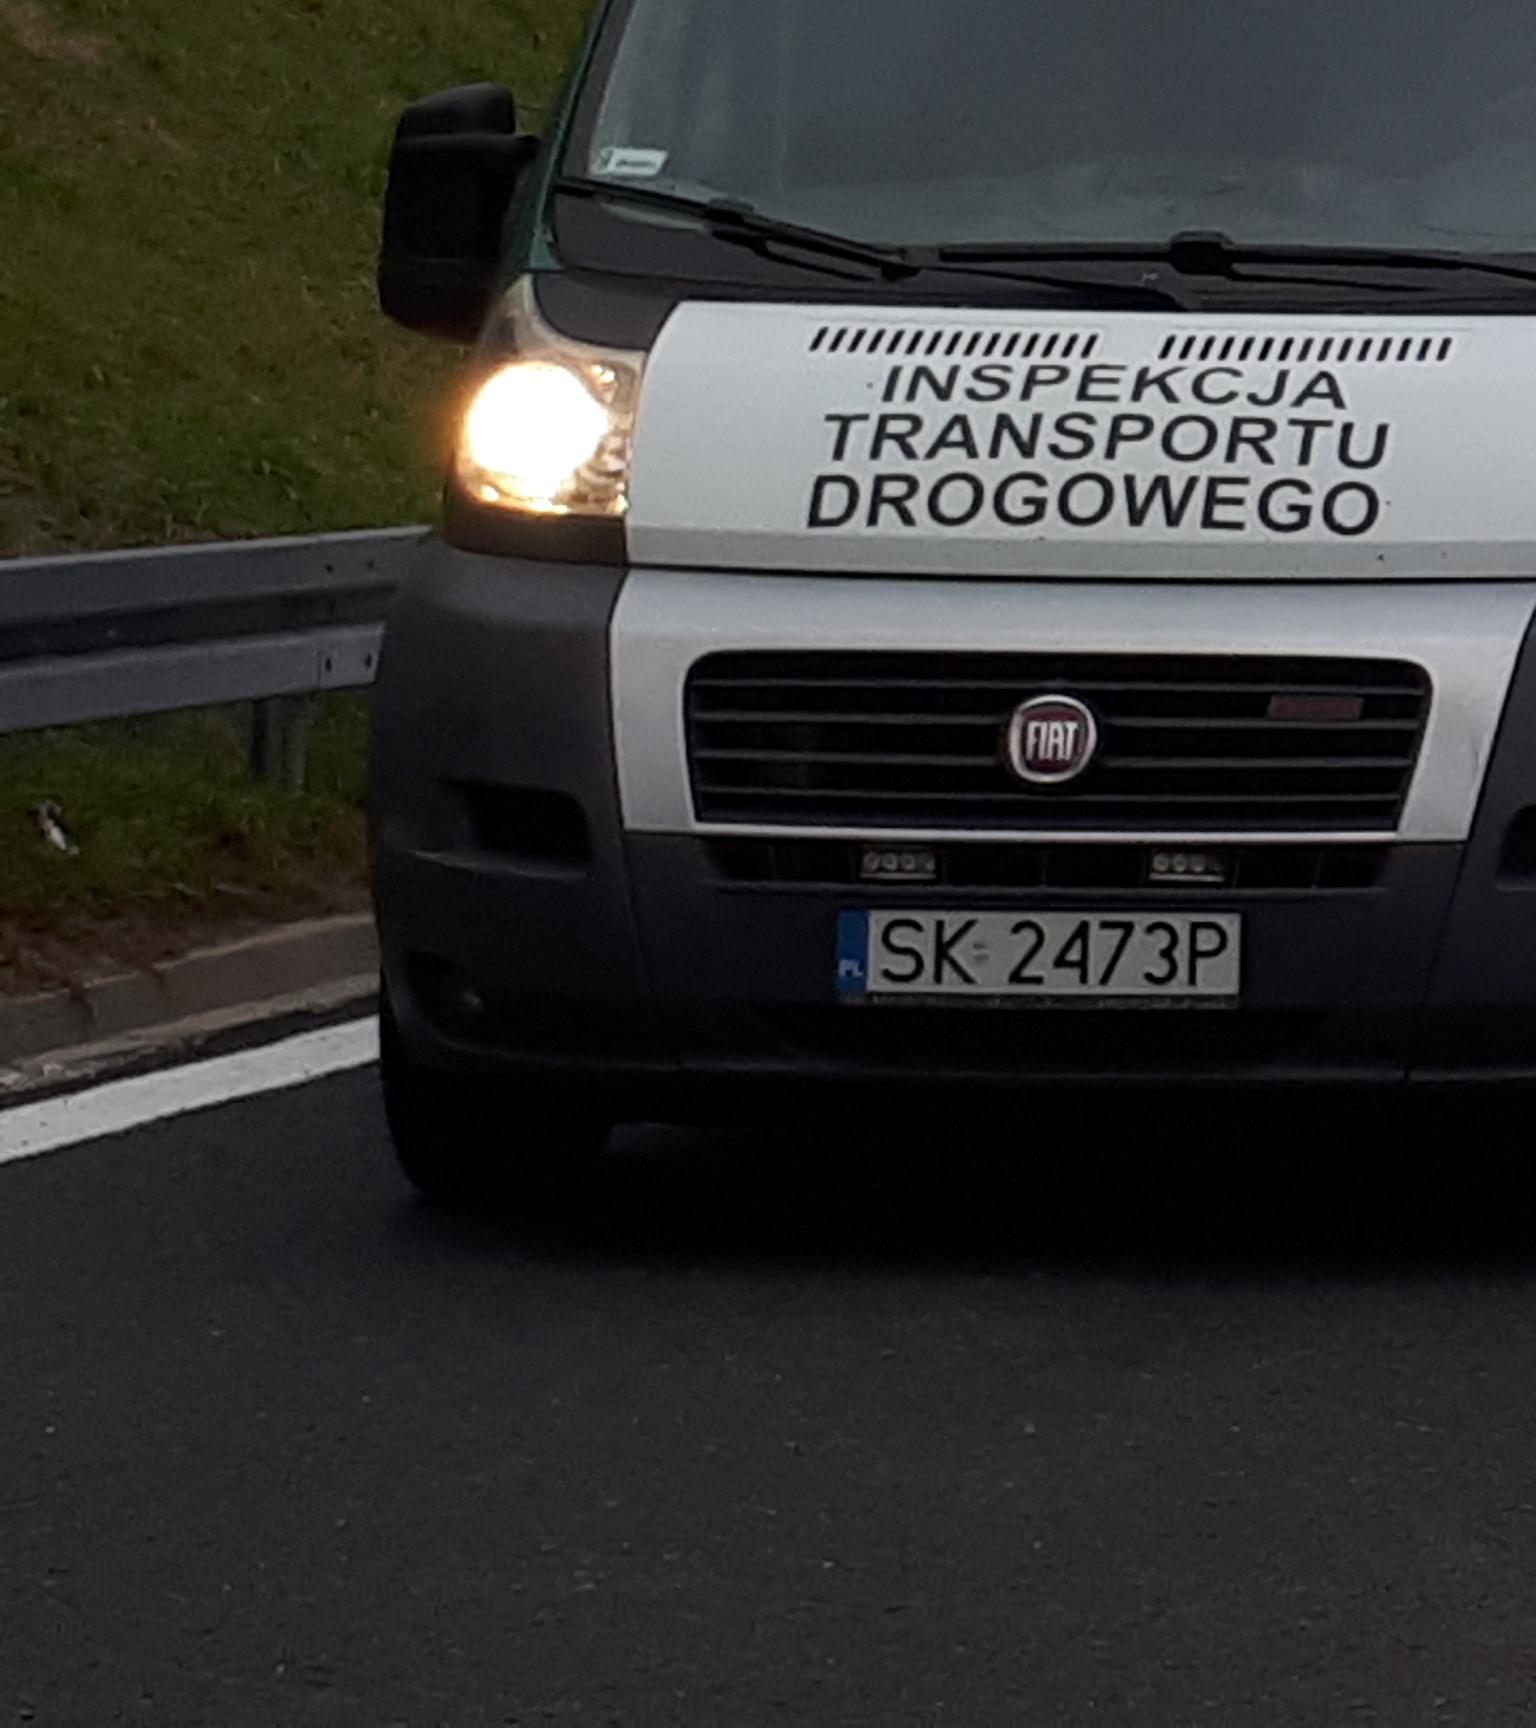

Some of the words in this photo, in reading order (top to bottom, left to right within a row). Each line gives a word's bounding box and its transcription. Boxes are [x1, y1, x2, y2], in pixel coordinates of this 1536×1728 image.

[881, 364, 1347, 410] INSPEKCJA
[824, 412, 1389, 469] TRANSPORTU
[806, 473, 1382, 536] DROGOWEGO
[1025, 720, 1079, 761] FIAT
[881, 918, 978, 985] SK
[1008, 919, 1229, 987] 2473P
